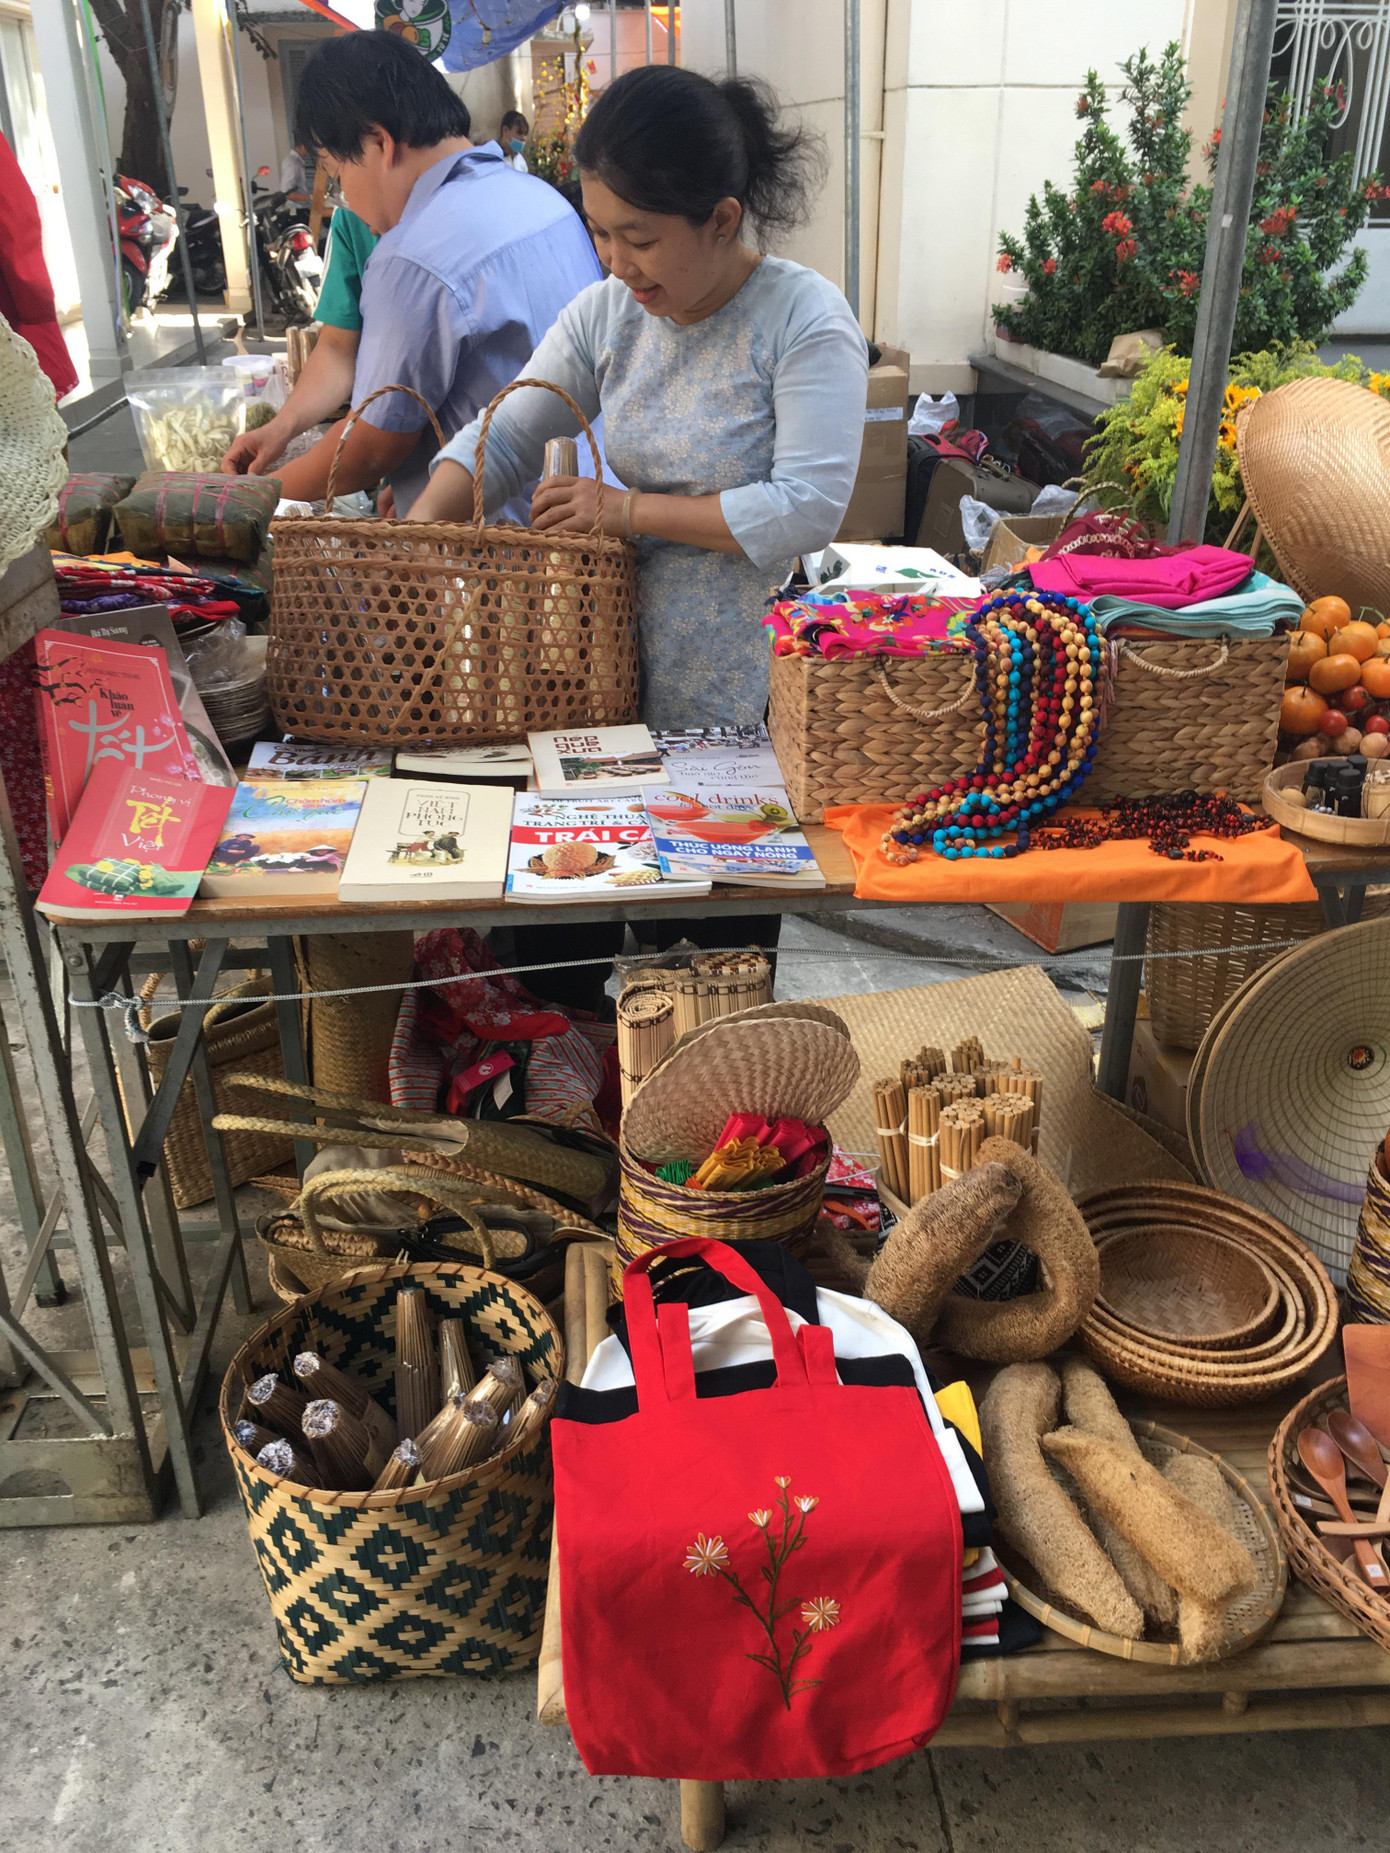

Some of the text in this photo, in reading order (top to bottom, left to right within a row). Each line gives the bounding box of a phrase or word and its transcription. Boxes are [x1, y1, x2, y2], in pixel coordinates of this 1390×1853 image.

[654, 793, 780, 806] cool drinks
[534, 828, 611, 843] TRÁI
[676, 847, 709, 855] CHO
